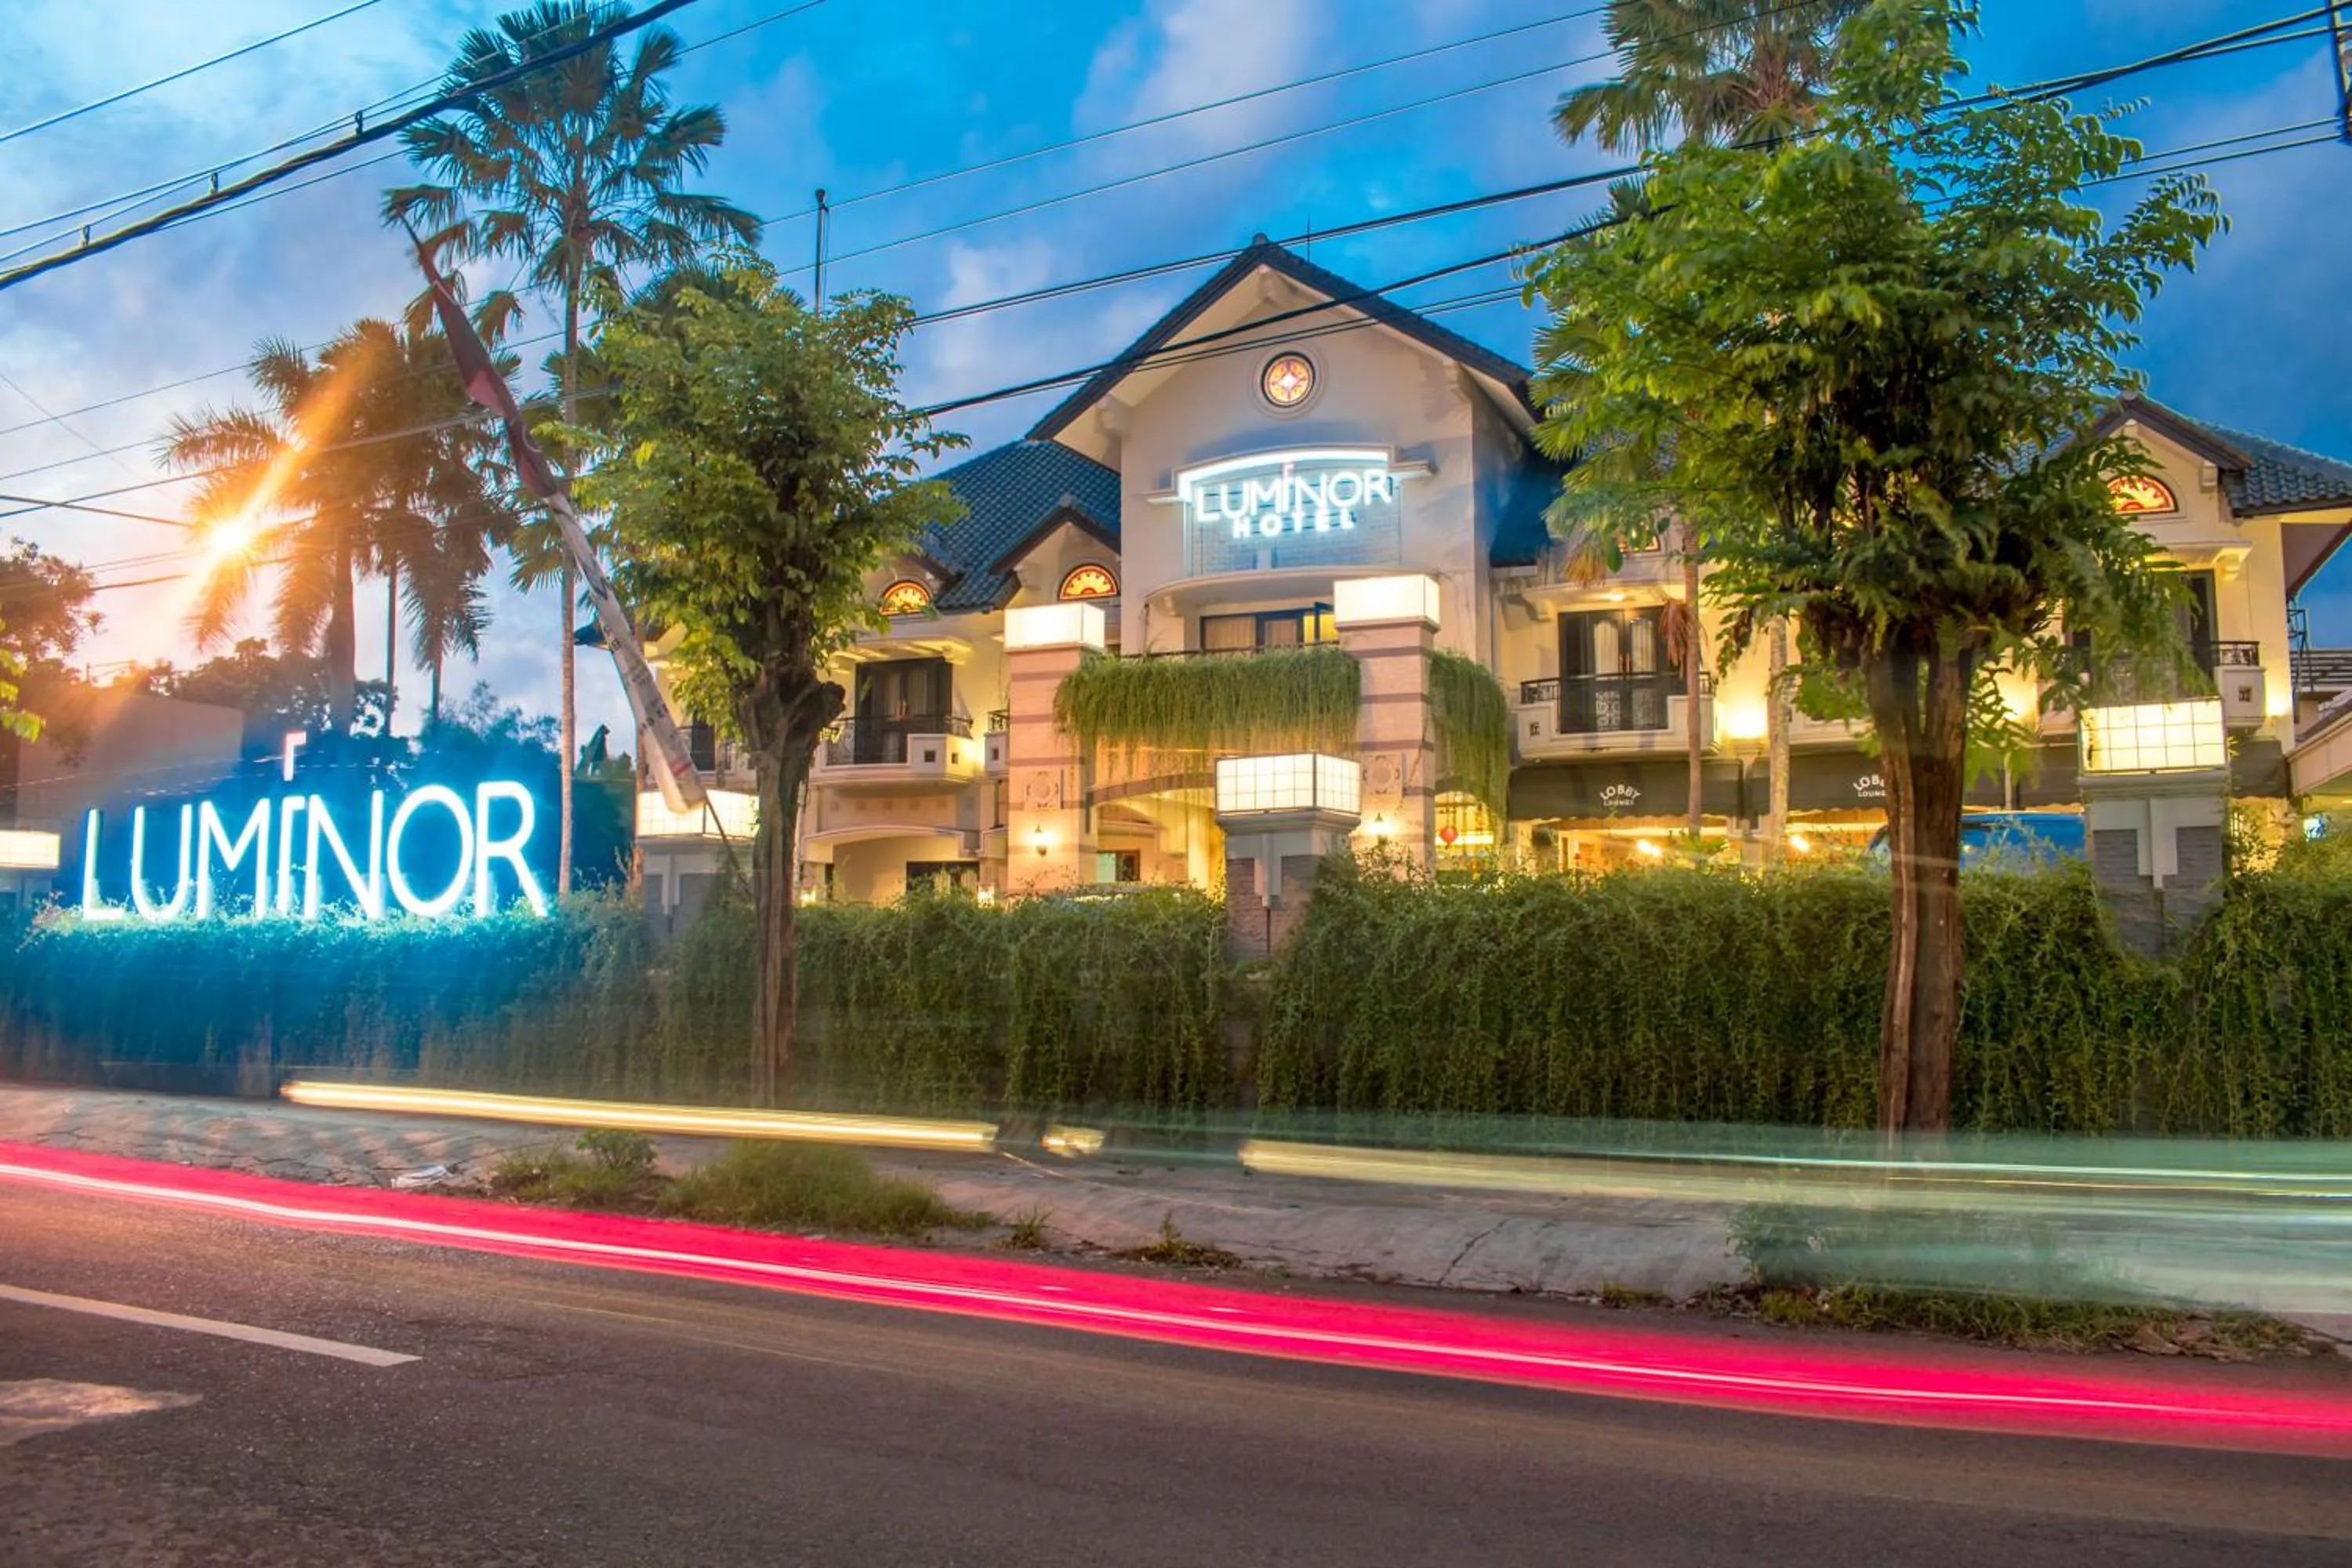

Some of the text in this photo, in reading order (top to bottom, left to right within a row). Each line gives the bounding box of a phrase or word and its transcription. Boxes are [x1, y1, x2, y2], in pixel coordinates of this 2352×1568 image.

[1196, 461, 1392, 522] LUMINOR
[1232, 506, 1356, 539] HOTEL
[1599, 784, 1642, 800] LOBBY
[82, 731, 547, 920] LUMINOR
